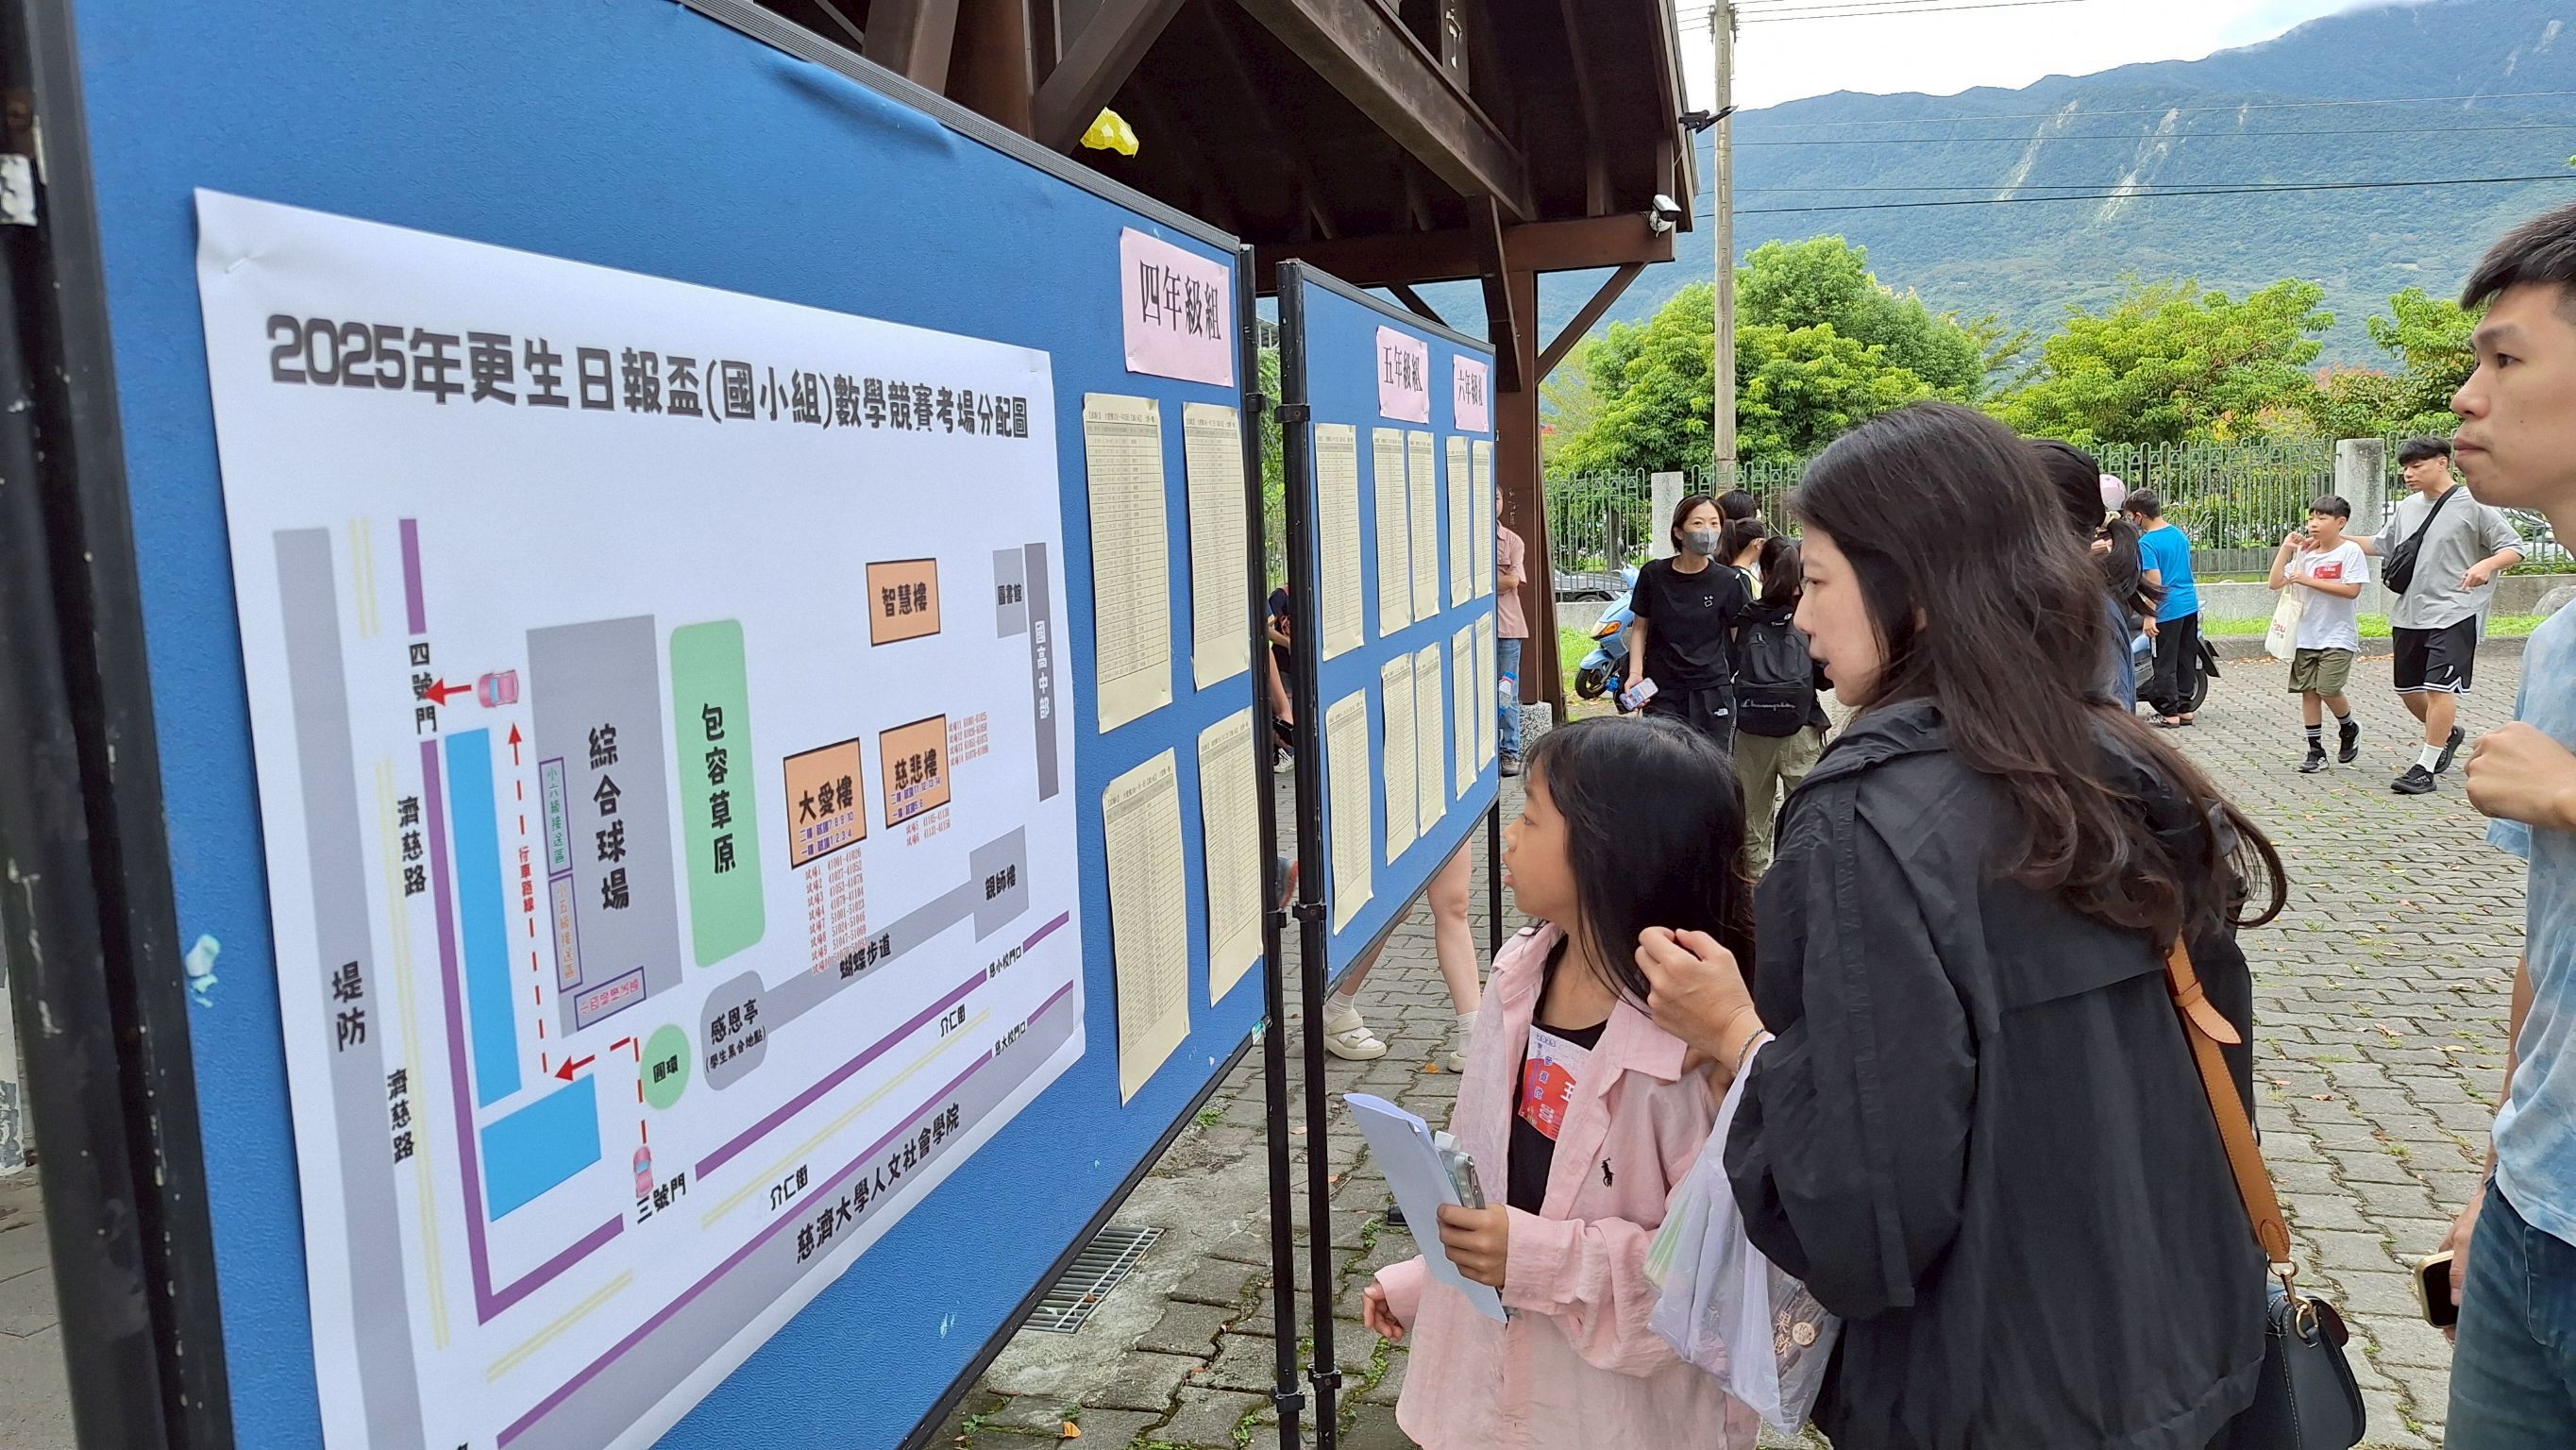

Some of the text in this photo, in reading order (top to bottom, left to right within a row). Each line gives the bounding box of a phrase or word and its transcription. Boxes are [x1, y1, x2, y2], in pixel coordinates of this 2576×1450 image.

[1139, 259, 1221, 340] 四年級組
[266, 313, 1029, 439] 2025年更生日報盃(國小組)數學競賽考場分配圖
[1383, 345, 1423, 392] 五年級組
[882, 581, 927, 617] 智慧樓
[997, 582, 1022, 605] 圖書館
[409, 642, 438, 734] 四號門
[1035, 619, 1050, 719] 國高中部
[701, 702, 736, 875] 包容草原
[894, 748, 937, 790] 慈悲樓
[588, 722, 630, 911] 綜合球場
[799, 775, 853, 825] 大愛樓
[397, 796, 427, 898] 濟慈路
[518, 846, 535, 913] 行車路線
[839, 932, 891, 980] 蝴蝶步道
[989, 945, 1021, 979] 慈小校門口
[332, 960, 365, 1053] 堤防
[711, 998, 758, 1045] 感恩亭
[706, 1025, 766, 1072] (學生集合地點)
[995, 1020, 1026, 1057] 慈大校門口
[653, 1054, 679, 1084] 圓環
[387, 1068, 415, 1164] 濟慈路
[637, 1172, 686, 1224] 三號門
[796, 1102, 960, 1265] 慈濟大學人文社會學院
